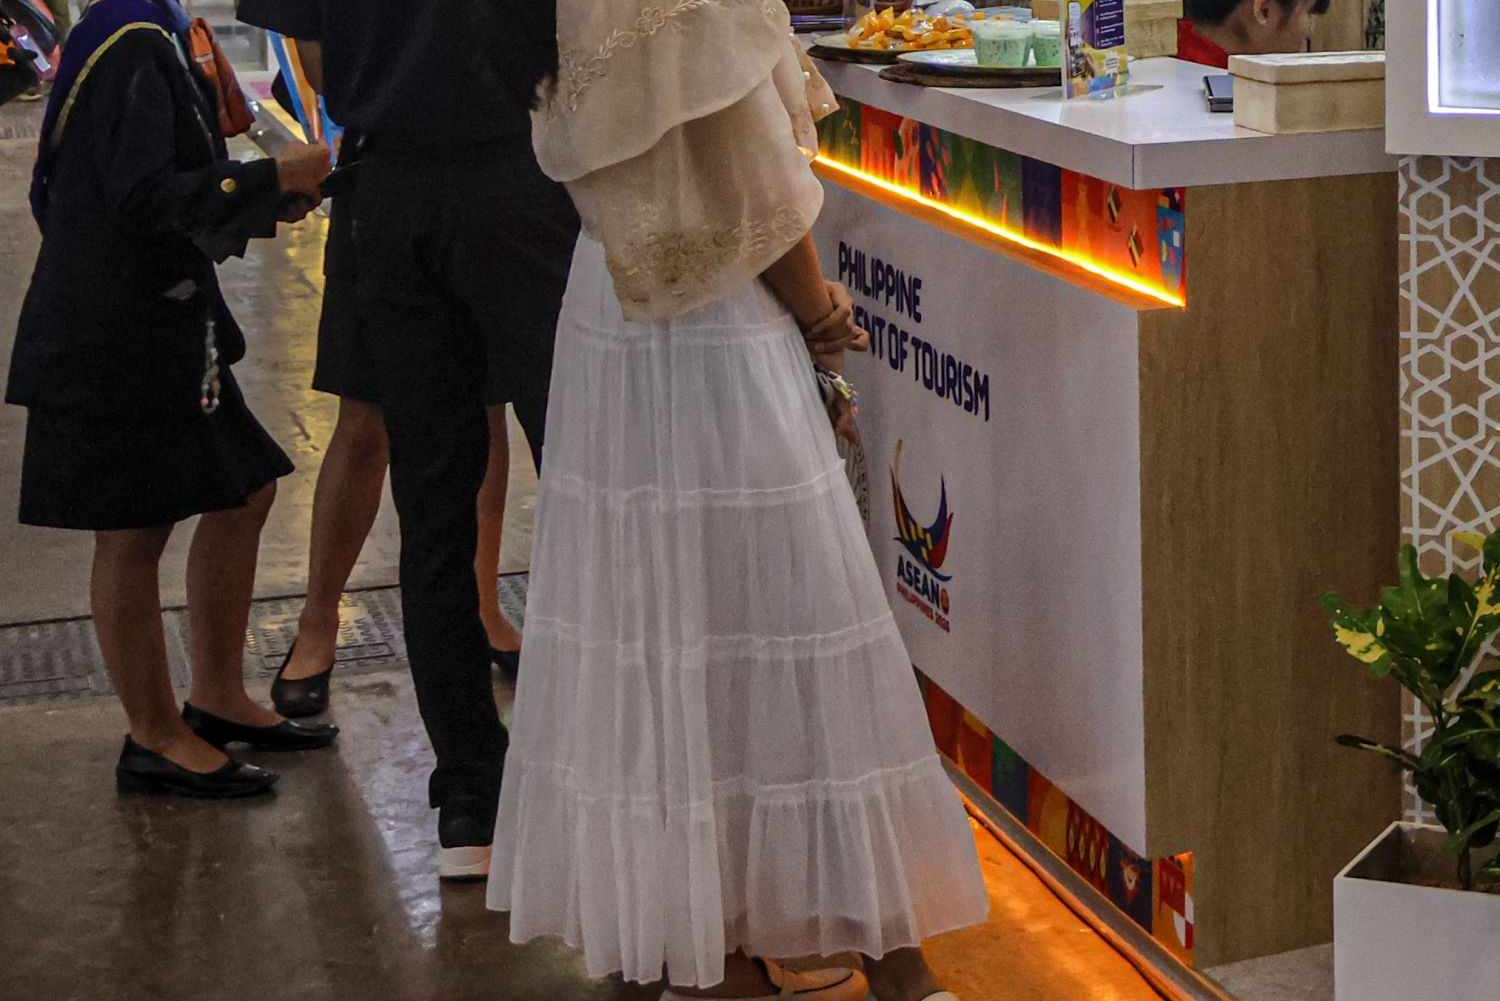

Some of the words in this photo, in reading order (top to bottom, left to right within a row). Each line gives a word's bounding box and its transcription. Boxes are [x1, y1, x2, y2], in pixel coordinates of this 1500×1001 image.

[839, 241, 922, 323] PHILIPPINE
[888, 323, 908, 372] OF
[911, 337, 989, 421] TOURISM
[897, 555, 939, 608] ASEAN
